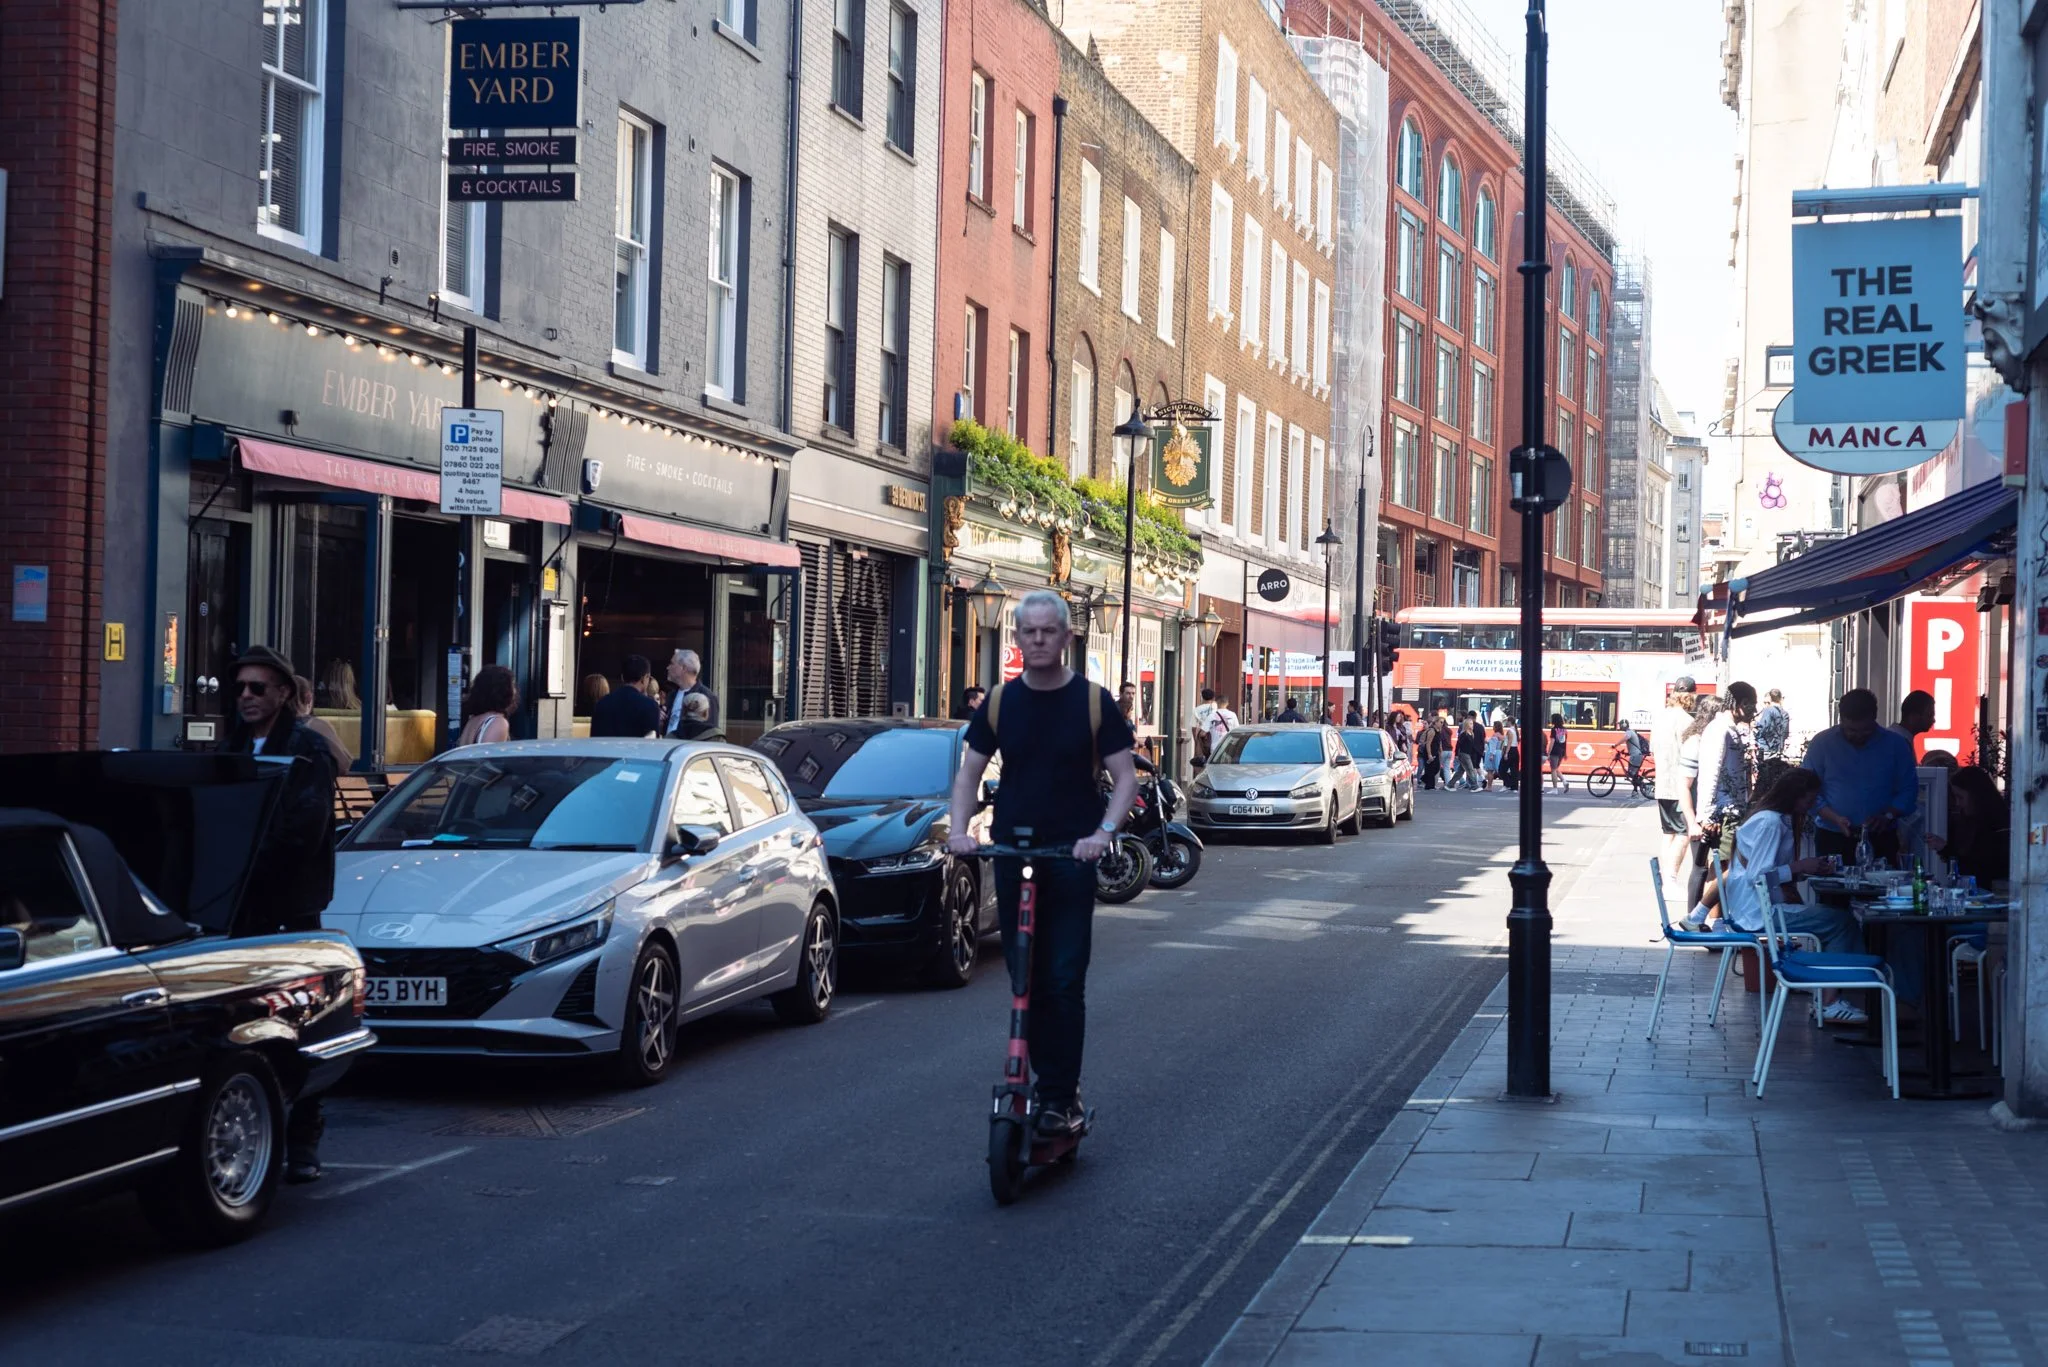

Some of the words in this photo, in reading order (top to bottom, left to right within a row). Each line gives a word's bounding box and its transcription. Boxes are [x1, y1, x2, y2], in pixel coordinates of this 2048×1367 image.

[460, 41, 570, 70] EMBER
[467, 77, 555, 104] YARD
[463, 142, 500, 158] FIRE,
[505, 142, 560, 156] SMOKE
[461, 181, 472, 194] &
[475, 179, 562, 194] COCKTAILS
[1831, 265, 1912, 297] THE
[1824, 303, 1933, 336] REAL
[1808, 341, 1946, 376] GREEK
[322, 368, 398, 421] EMBER
[1157, 404, 1210, 417] NICHOLSON'S
[455, 426, 467, 442] P
[1808, 425, 1927, 448] MANCA
[443, 460, 468, 468] 07860
[626, 453, 646, 472] FIRE
[655, 461, 684, 483] SMOKE
[692, 471, 734, 496] COCKTAILS
[1191, 494, 1207, 502] MAN
[1260, 579, 1287, 592] ARRO
[1254, 806, 1270, 814] NWG
[396, 980, 439, 1001] BYH
